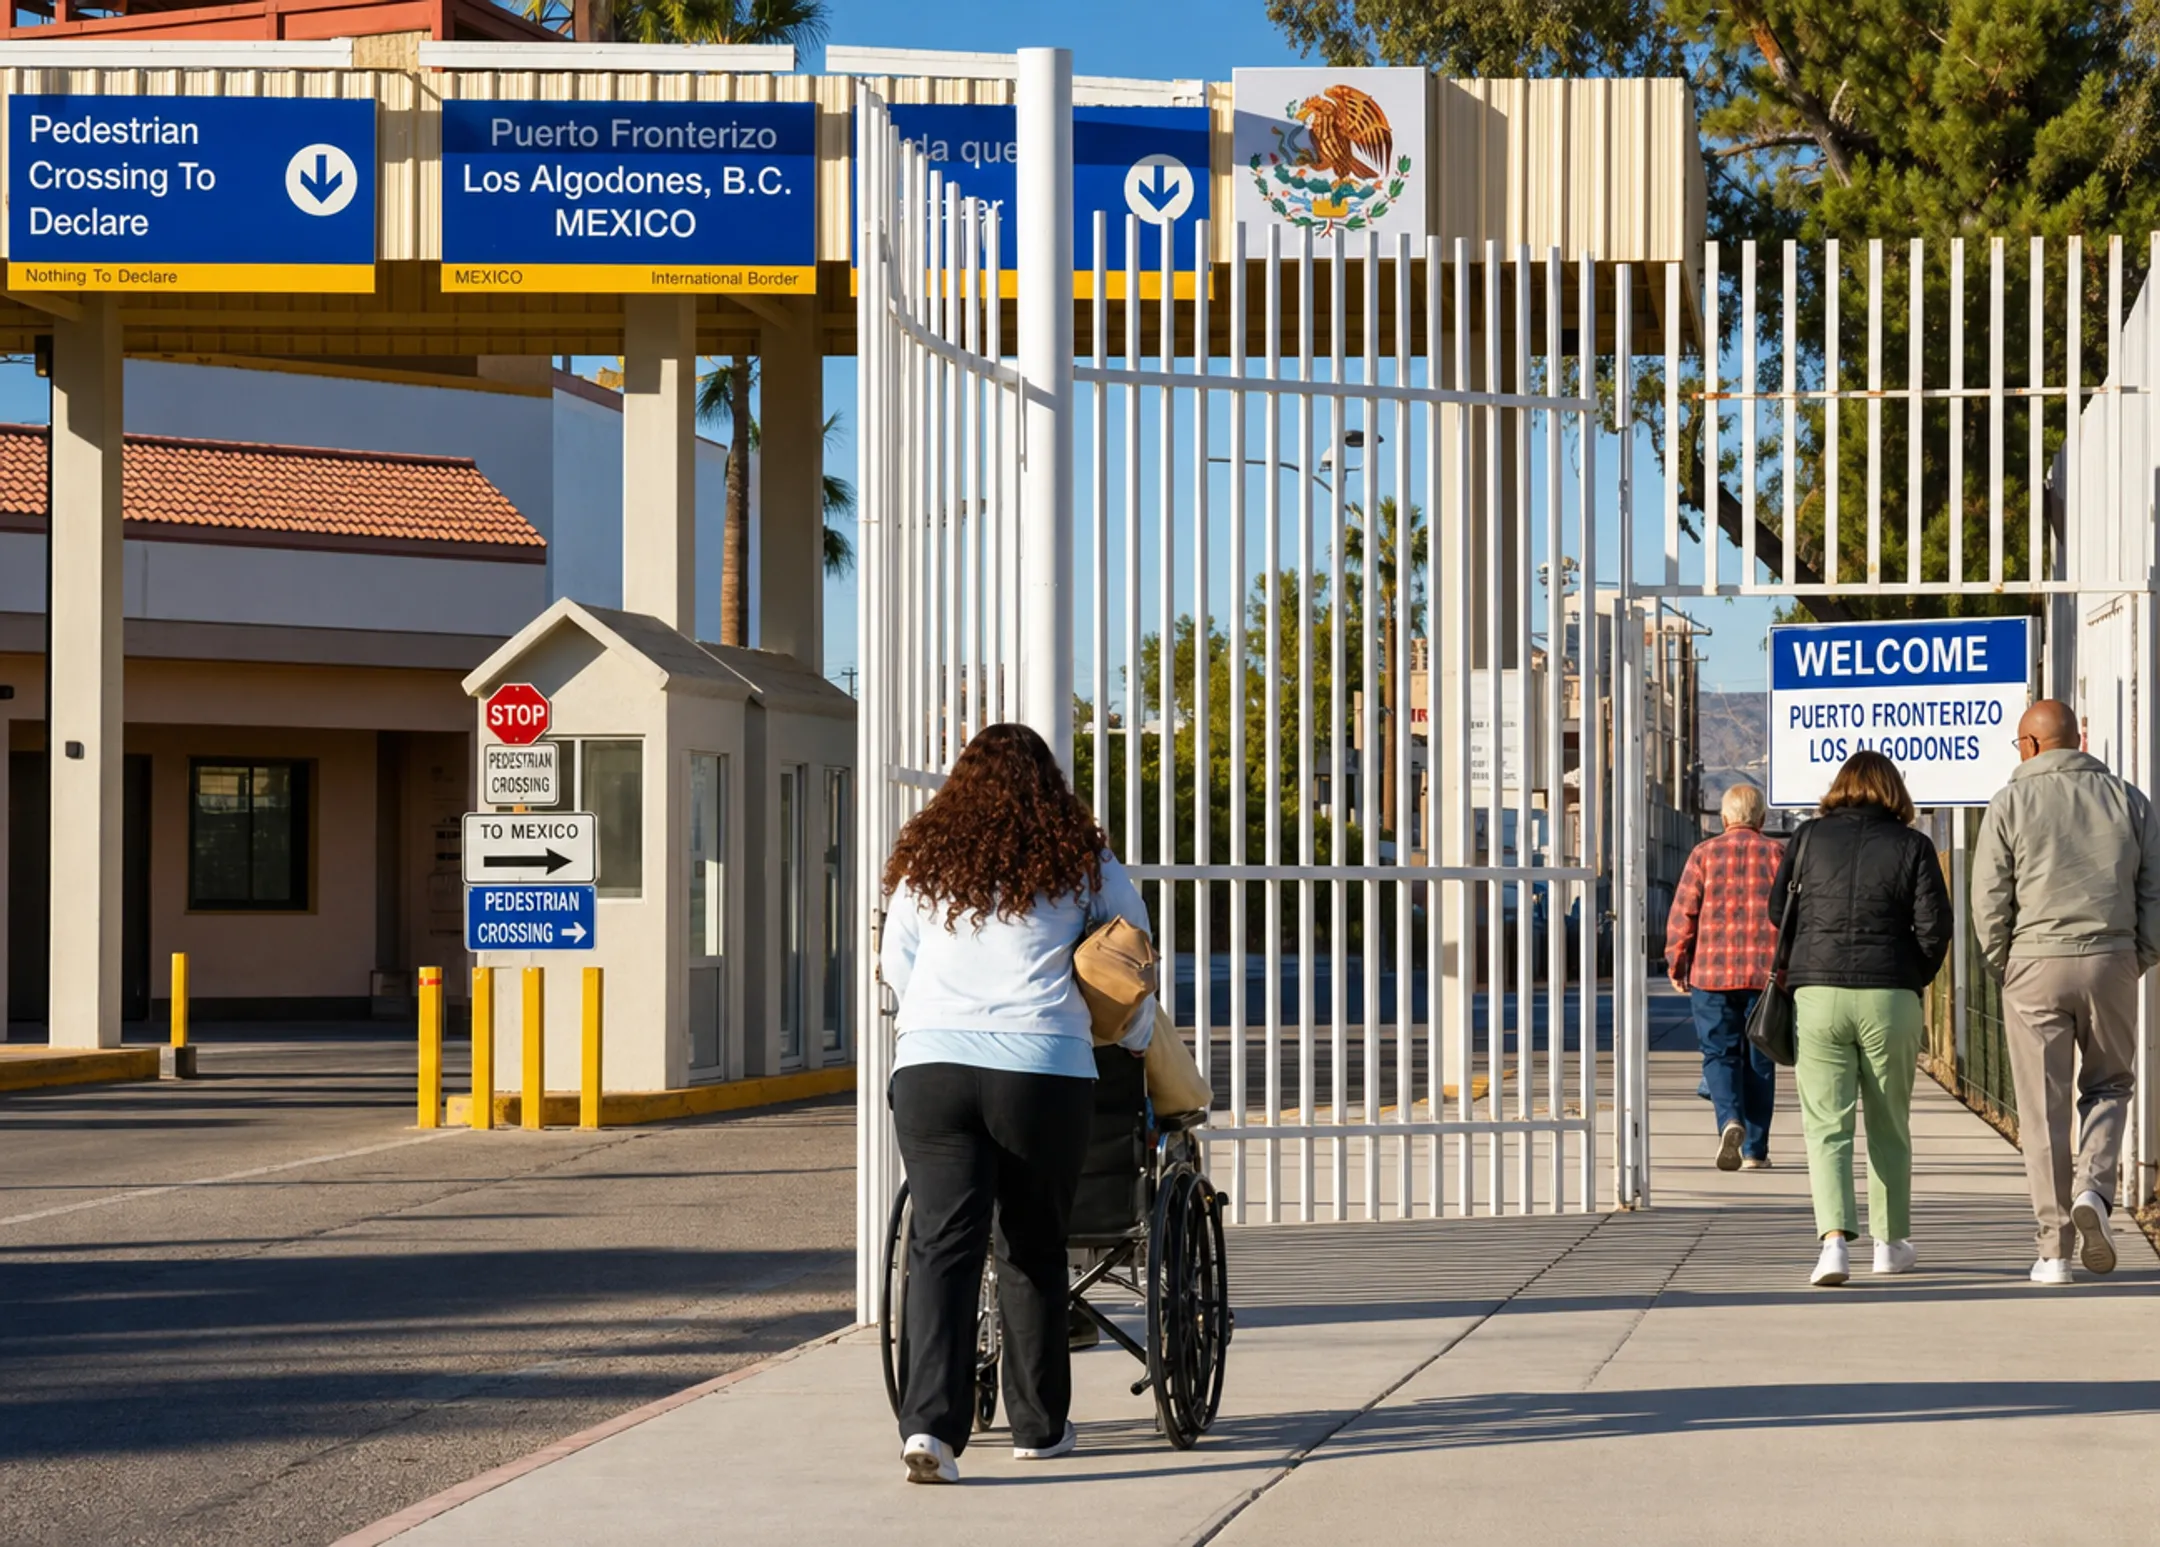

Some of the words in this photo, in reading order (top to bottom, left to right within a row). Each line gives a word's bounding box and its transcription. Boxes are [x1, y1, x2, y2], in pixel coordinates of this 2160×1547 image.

[30, 115, 199, 145] Pedestrian
[491, 118, 599, 147] Puerto
[611, 119, 777, 149] Fronterizo
[961, 140, 1017, 169] que
[29, 161, 168, 198] Crossing
[177, 162, 216, 191] To
[464, 163, 521, 193] Los
[529, 165, 711, 200] Algodones,
[723, 167, 791, 195] B.C.
[30, 206, 149, 236] Declare
[556, 208, 697, 238] MEXICO
[25, 268, 86, 287] Nothing
[92, 268, 112, 283] To
[118, 268, 178, 284] Declare
[454, 269, 524, 285] MEXICO
[651, 271, 743, 286] International
[748, 271, 800, 288] Border
[1792, 635, 1988, 677] WELCOME
[490, 703, 546, 727] STOP
[1789, 703, 1865, 730] PUERTO
[1872, 700, 2004, 727] FRONTERIZO
[489, 751, 553, 770] PEDESTRIAN
[1809, 738, 1848, 764] LOS
[491, 776, 550, 794] CROSSING
[480, 823, 503, 840] TO
[511, 823, 579, 840] MEXICO
[484, 891, 580, 912] PEDESTRIAN
[477, 922, 554, 944] CROSSING
